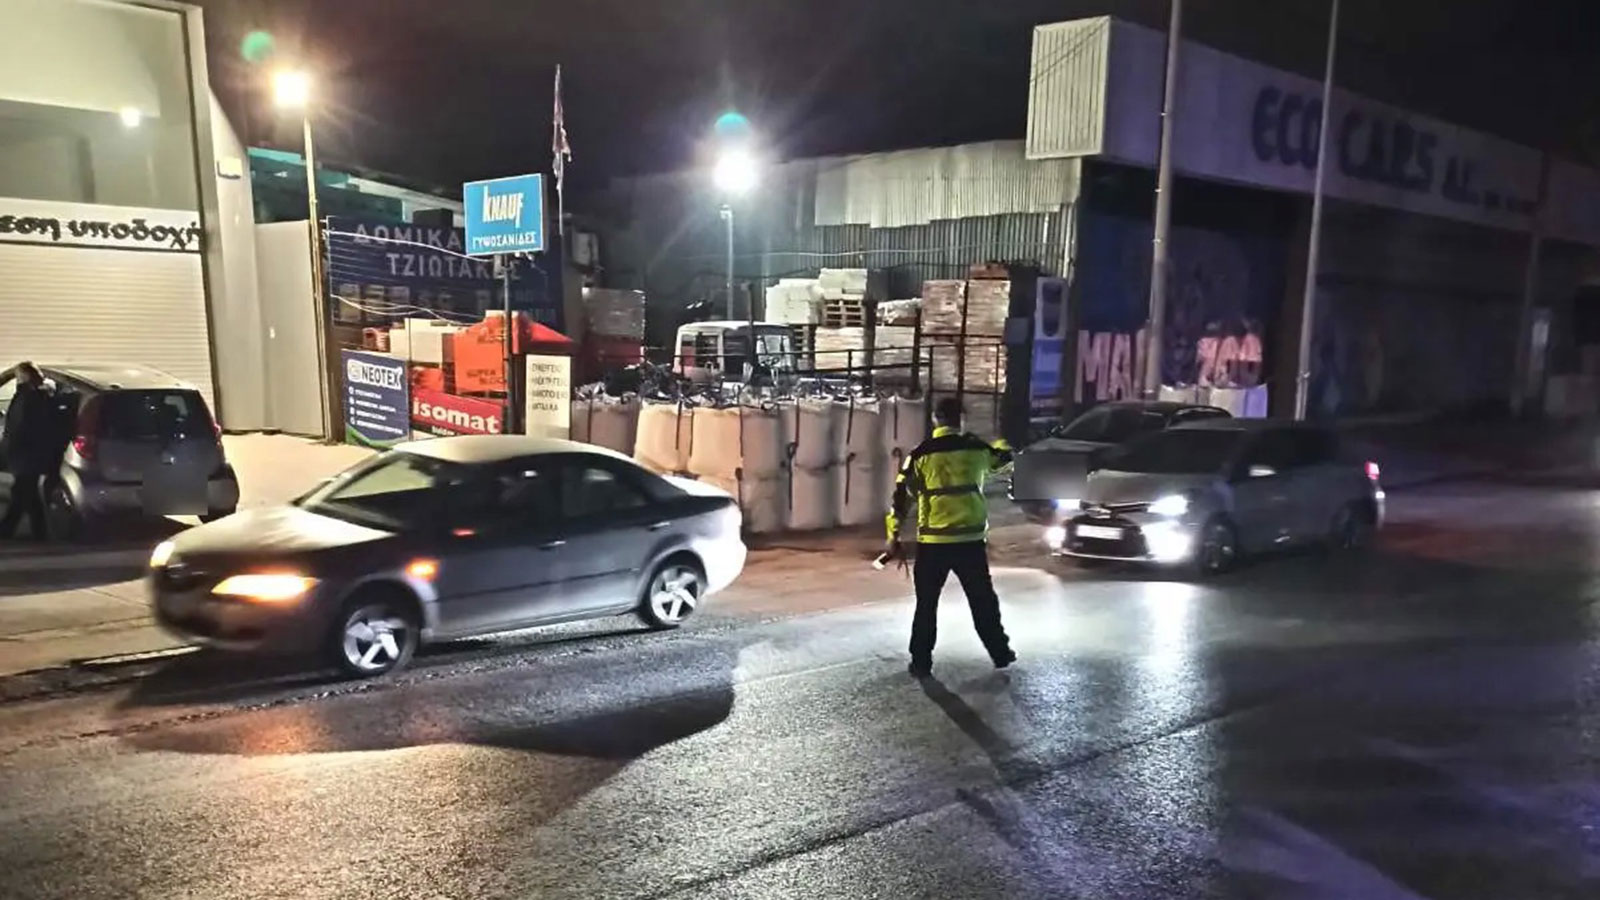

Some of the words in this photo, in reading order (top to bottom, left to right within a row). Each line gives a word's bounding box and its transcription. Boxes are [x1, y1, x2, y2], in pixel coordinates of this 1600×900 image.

[472, 231, 537, 250] ΓΥΨΟΣΑΝΙΔΕΣ
[385, 253, 521, 280] ΤΖΙΩΤΑΚΣ
[361, 365, 401, 387] NEOTEX
[412, 397, 500, 434] isomat
